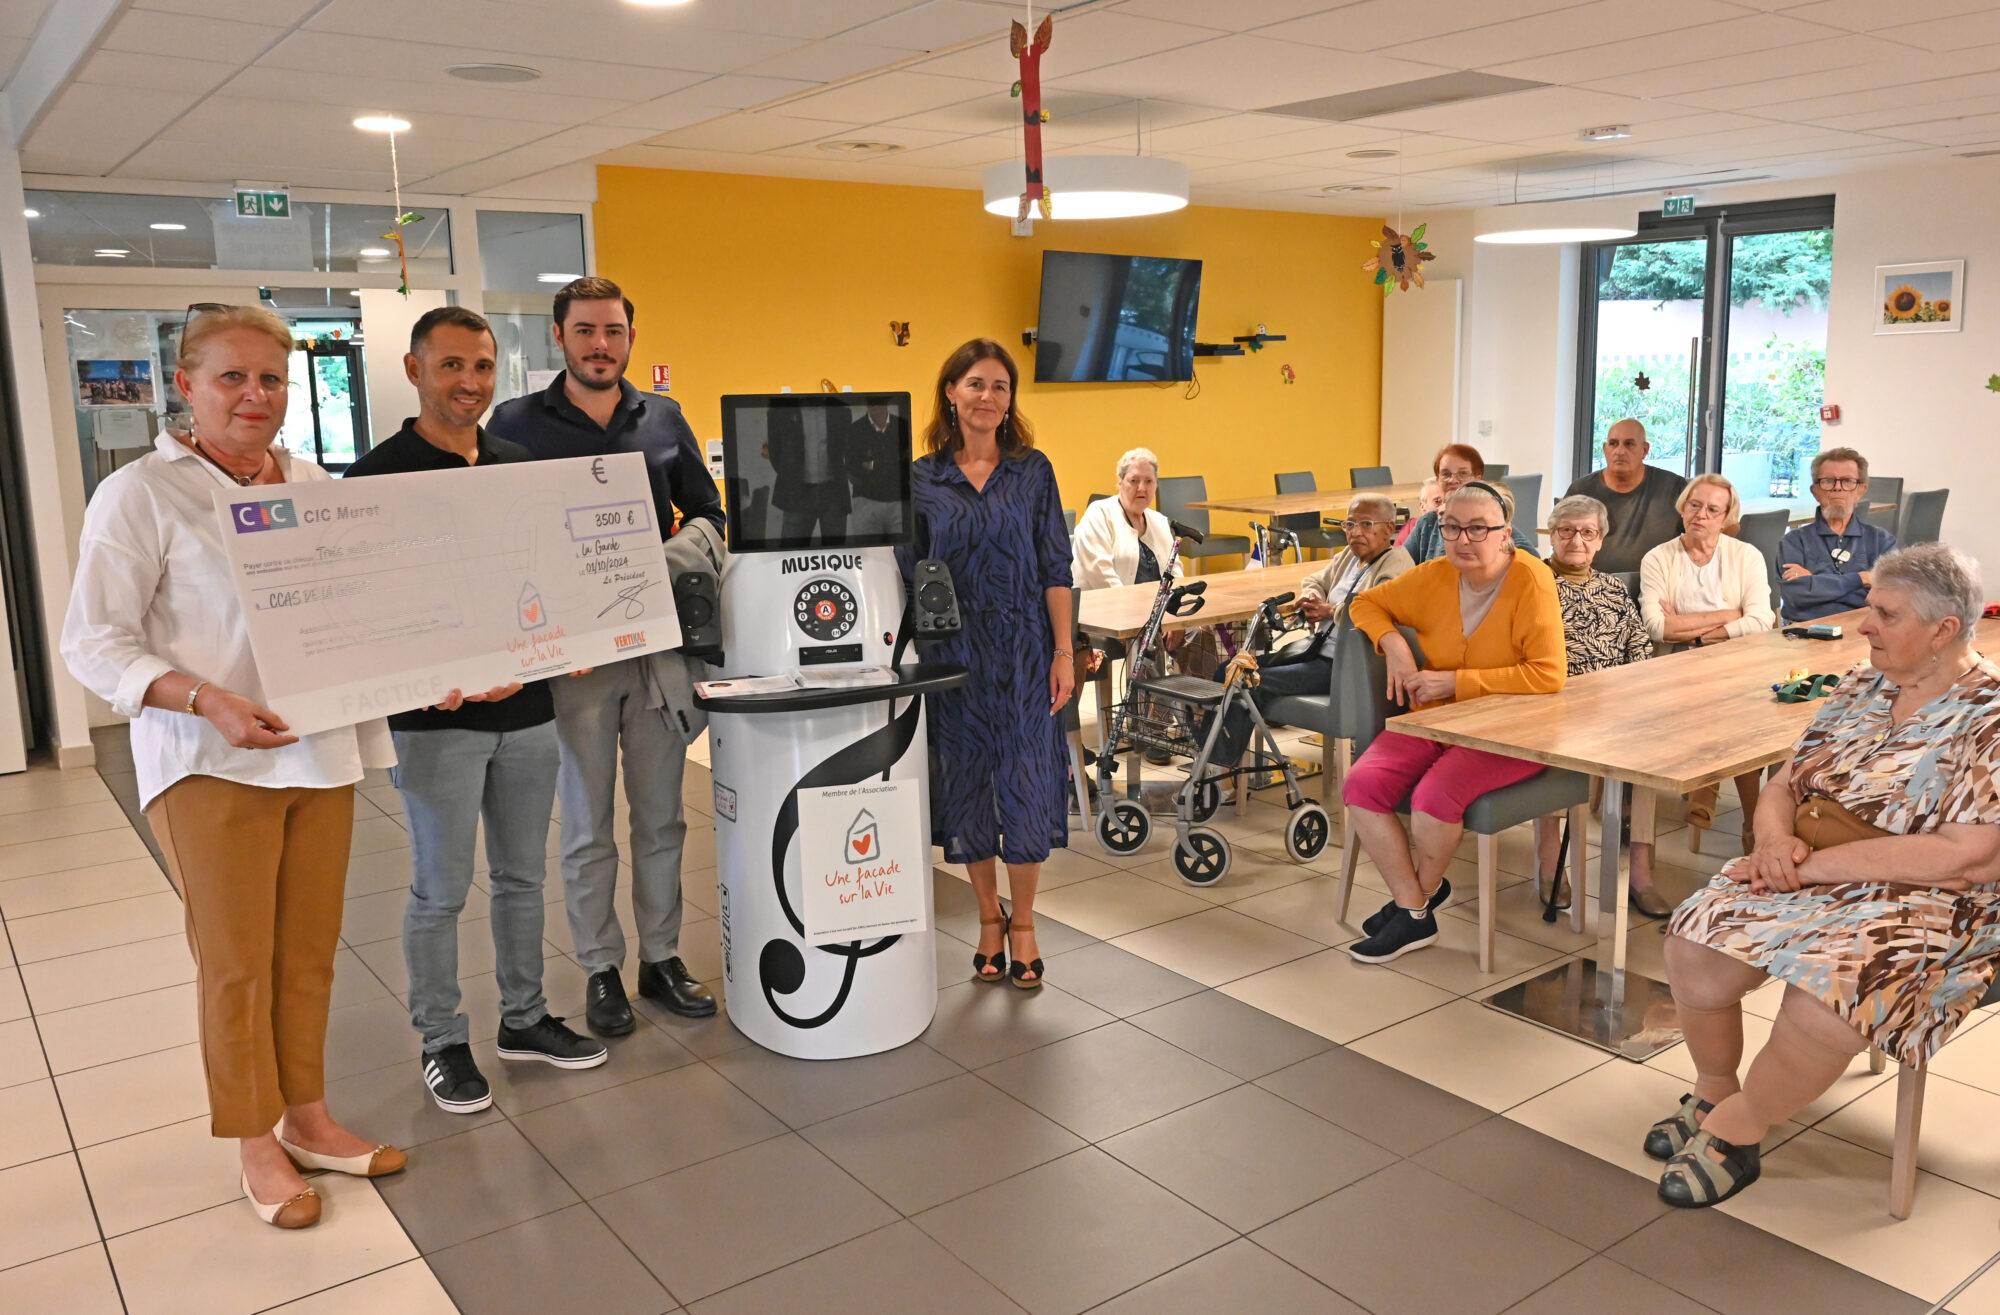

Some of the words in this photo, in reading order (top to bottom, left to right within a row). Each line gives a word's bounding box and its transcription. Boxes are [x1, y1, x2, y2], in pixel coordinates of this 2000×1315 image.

[239, 503, 288, 527] CIC
[303, 508, 332, 524] CIC
[594, 511, 621, 528] 3500
[595, 537, 621, 556] Garde
[781, 554, 863, 575] MUSIQUE
[269, 590, 302, 609] CCAS
[341, 675, 445, 716] FACTICE
[821, 790, 848, 799] Membre
[849, 788, 857, 796] de
[858, 785, 898, 796] l'Association
[825, 870, 851, 886] Une
[840, 892, 858, 904] sur
[861, 884, 873, 899] la
[874, 881, 895, 896] Vie
